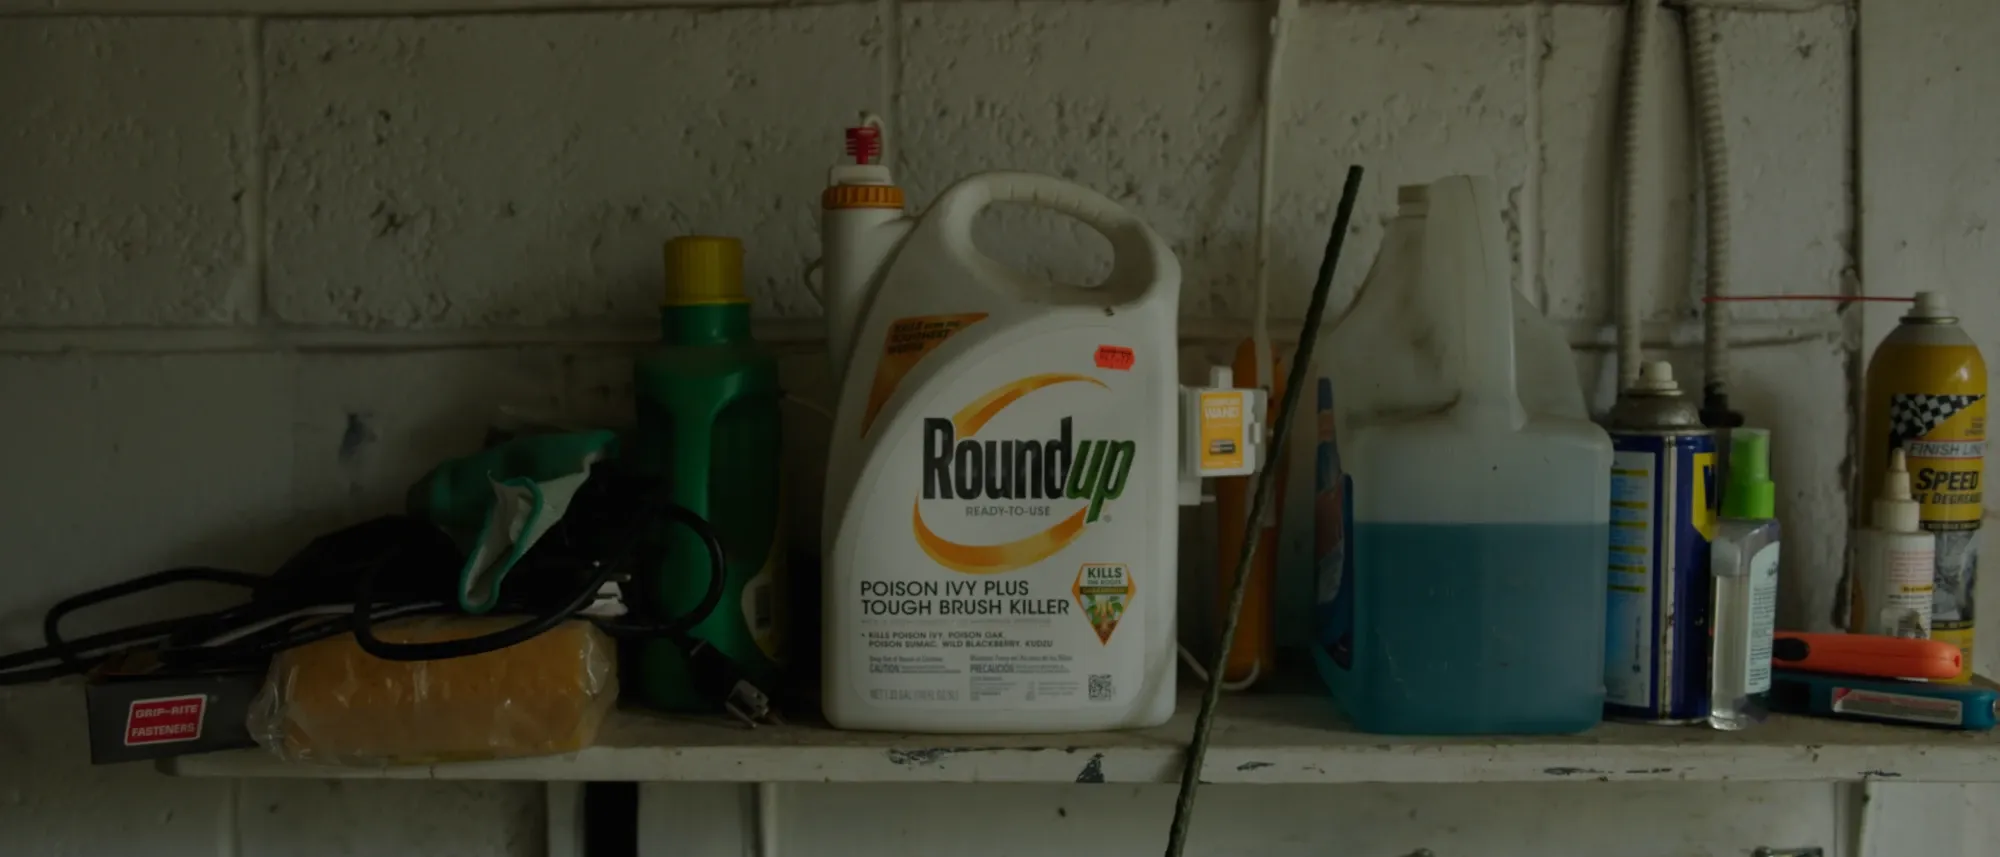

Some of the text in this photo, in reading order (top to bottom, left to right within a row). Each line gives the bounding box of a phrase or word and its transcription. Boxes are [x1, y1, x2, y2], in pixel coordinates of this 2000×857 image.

[1910, 442, 1960, 455] FINISH
[923, 416, 1136, 524] Roundup
[1915, 467, 1980, 491] SPEED
[965, 506, 1051, 517] READY-TO-USE
[1087, 567, 1123, 578] KILLS
[860, 581, 1029, 596] POISON IVY PLUS
[862, 599, 1070, 615] TOUGH BRUSH KILLER
[868, 631, 890, 639] KILLS
[892, 631, 927, 639] POISON
[948, 631, 982, 639] POISON
[868, 640, 903, 648] POISON
[942, 640, 964, 648] WILD
[1025, 640, 1054, 648] KUDZU
[135, 704, 199, 719] GRIP-RITE
[131, 722, 196, 737] FASTENERS
